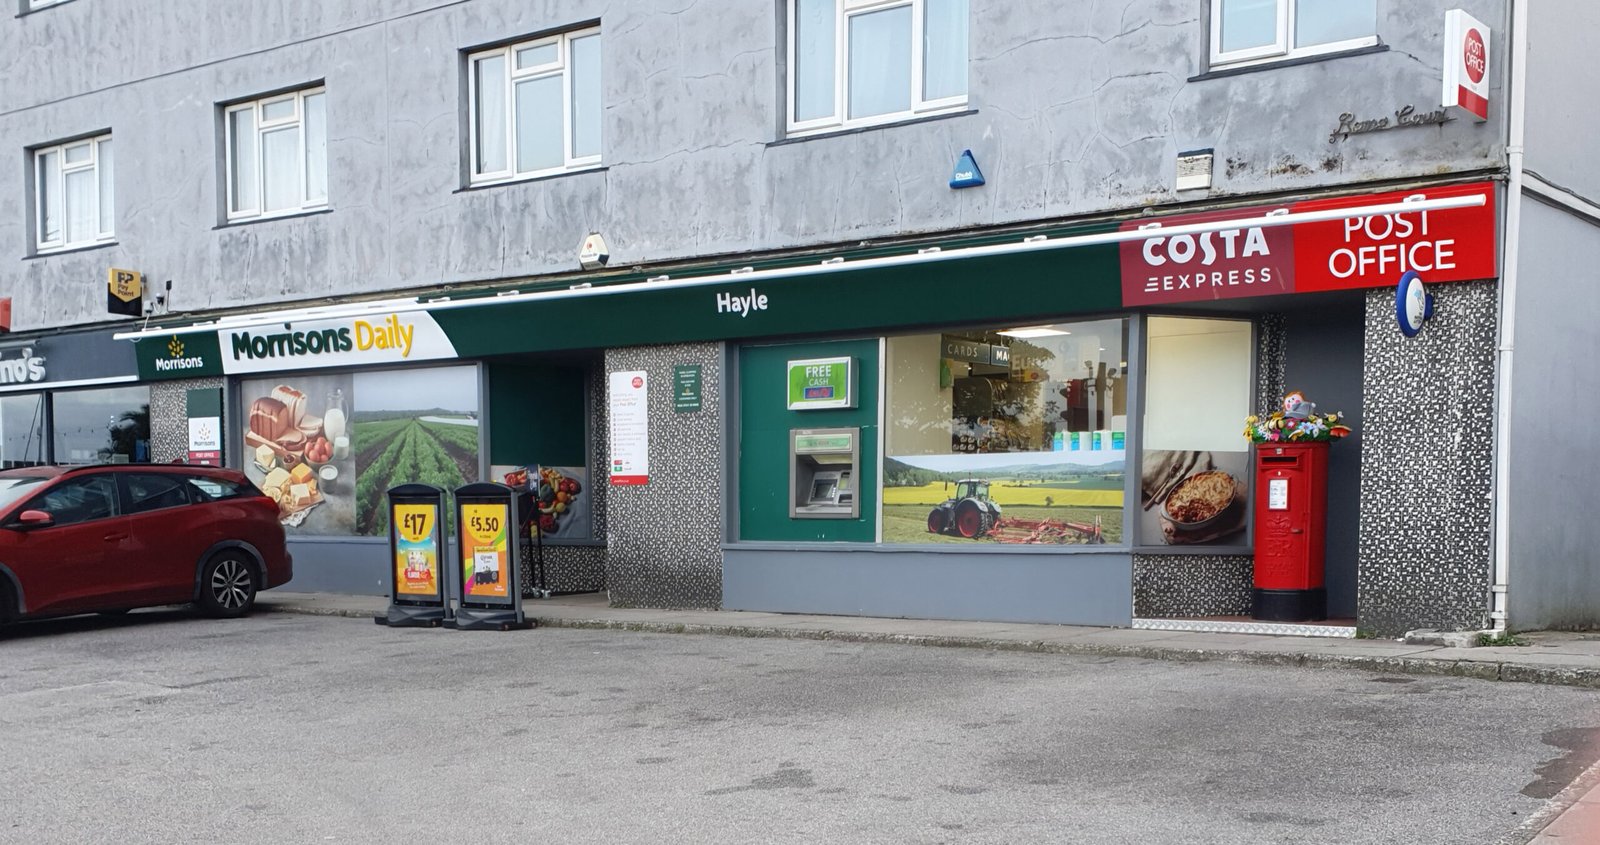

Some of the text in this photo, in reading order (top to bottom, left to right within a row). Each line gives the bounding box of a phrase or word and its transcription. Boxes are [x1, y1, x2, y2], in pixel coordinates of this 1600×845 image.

[1468, 37, 1482, 57] POST
[1466, 52, 1484, 74] OFFICE
[1395, 104, 1449, 125] Court
[1142, 227, 1270, 266] COSTA
[1329, 239, 1456, 278] OFFICE
[1163, 267, 1271, 291] EXPRESS
[716, 288, 768, 318] Hayle
[231, 313, 414, 361] Morrisons Daily
[155, 355, 203, 371] Morrisons
[947, 344, 1010, 361] CARDS MA
[805, 365, 832, 378] FREE
[808, 377, 829, 386] CASH
[404, 513, 427, 535] £17
[471, 516, 499, 532] £5.50
